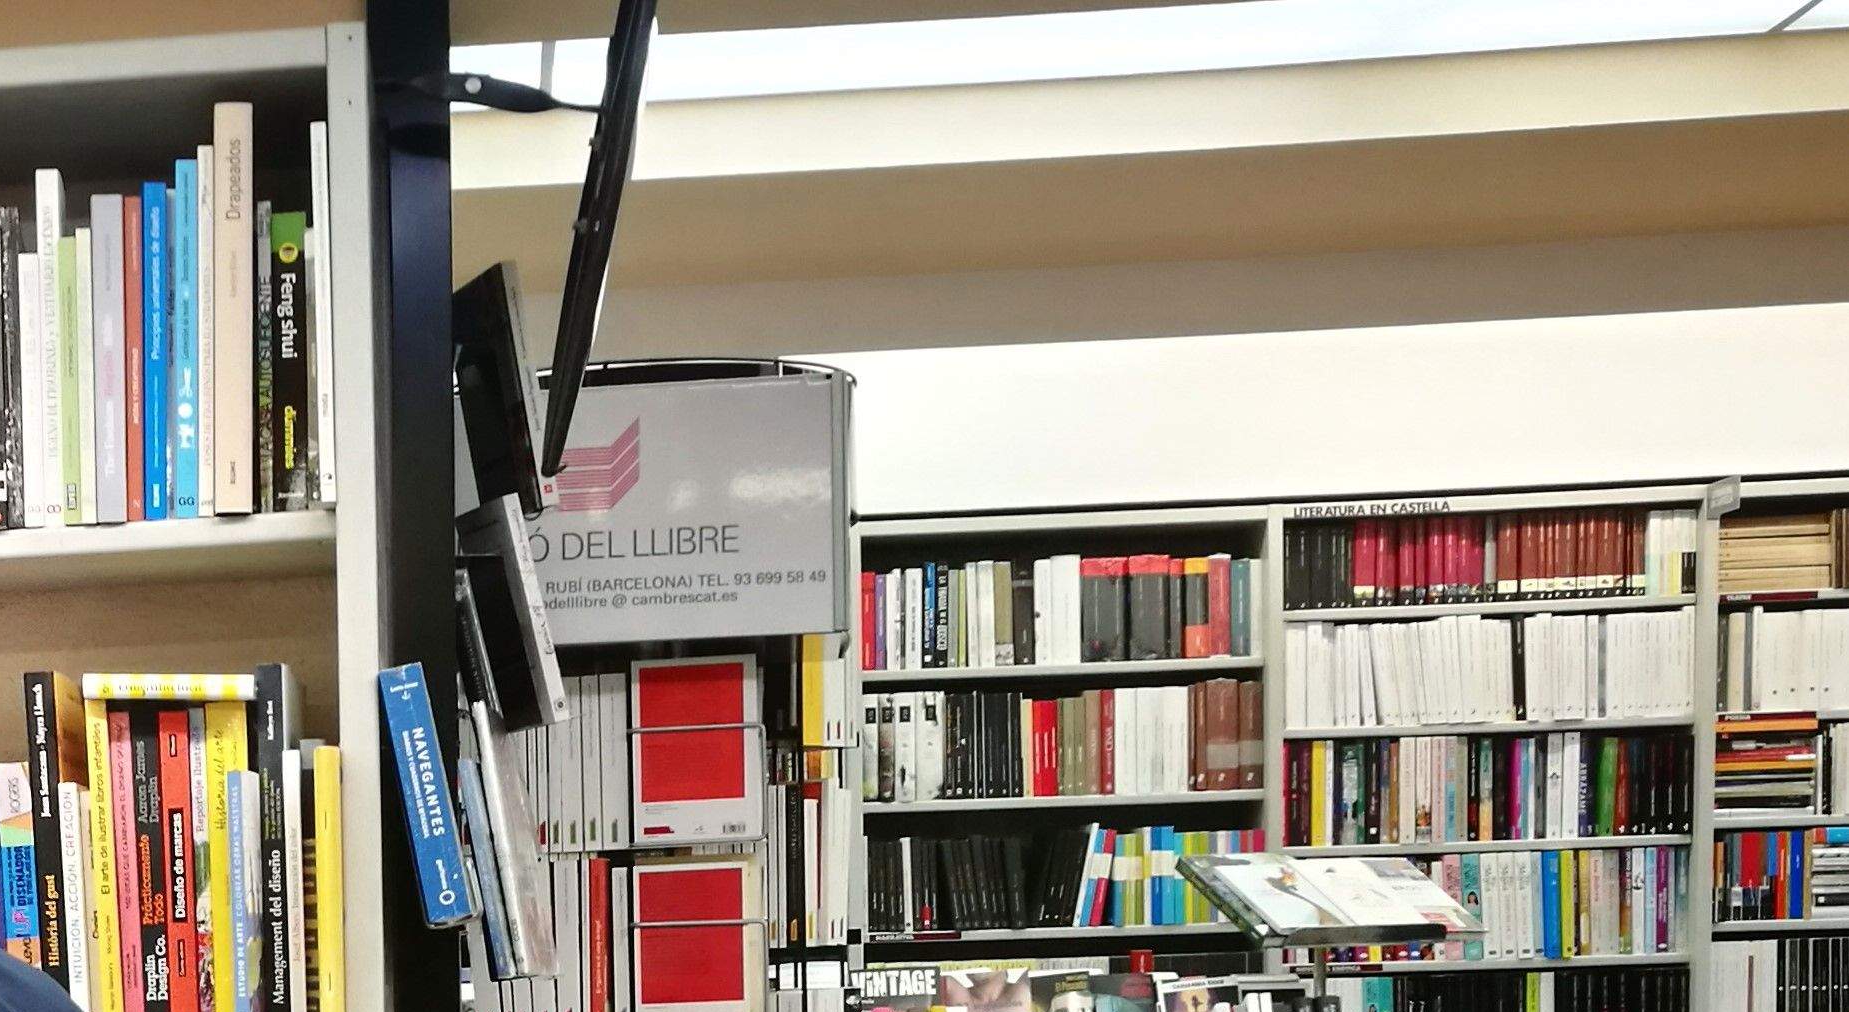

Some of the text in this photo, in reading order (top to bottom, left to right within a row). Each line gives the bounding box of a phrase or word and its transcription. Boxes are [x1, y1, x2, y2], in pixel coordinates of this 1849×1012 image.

[225, 137, 243, 220] Drapeados
[277, 272, 299, 359] Feng shui
[1293, 504, 1365, 518] LITERATURA
[1370, 502, 1387, 515] EN
[561, 530, 626, 561] DEL
[633, 525, 740, 557] LLIBRE
[545, 569, 827, 595] RUBÍ (BARCELONA) TEL. 93 699 58 49
[632, 591, 739, 607] cambrescat.es
[95, 774, 106, 803] libros
[411, 726, 446, 837] NAVEGANTES
[97, 805, 108, 842] ilustrar
[99, 861, 110, 882] arte
[173, 812, 186, 919] Diseño de marcas
[268, 849, 282, 893] diseño
[45, 874, 60, 968] Història del gust
[270, 895, 282, 917] del
[145, 953, 157, 1001] Draplin
[270, 920, 289, 1005] Management
